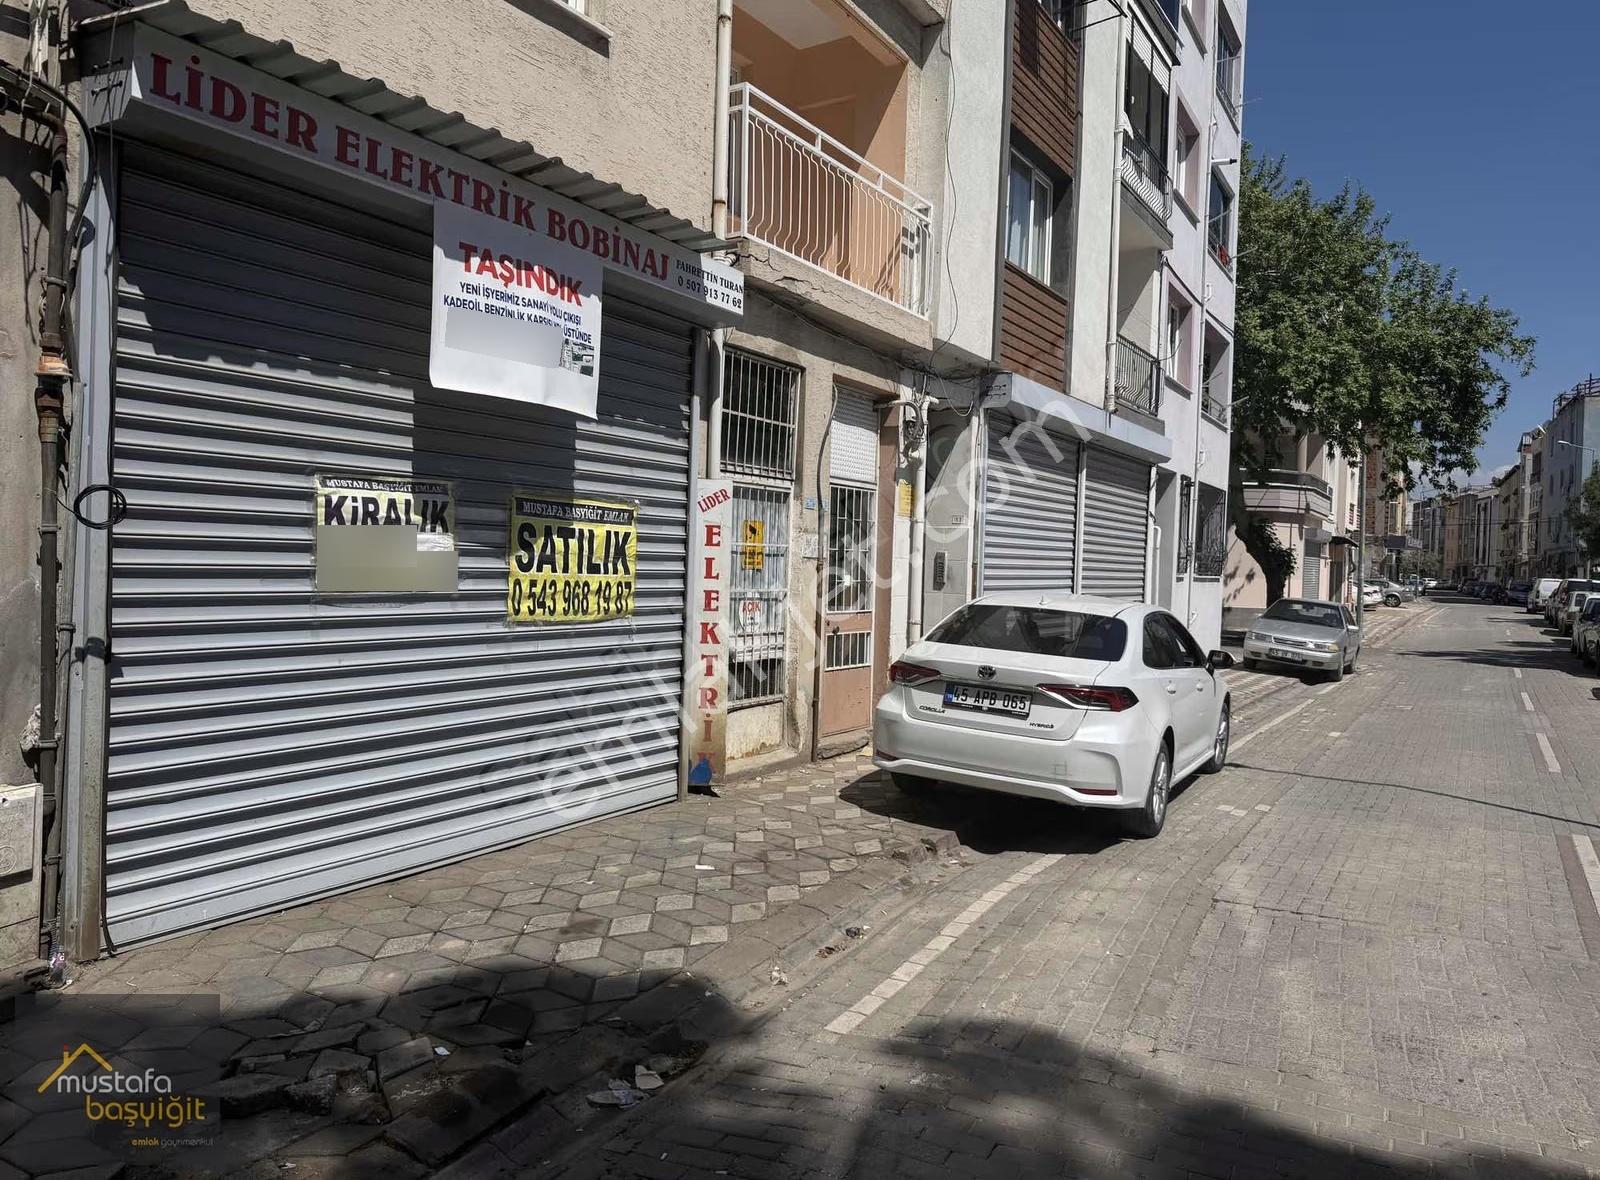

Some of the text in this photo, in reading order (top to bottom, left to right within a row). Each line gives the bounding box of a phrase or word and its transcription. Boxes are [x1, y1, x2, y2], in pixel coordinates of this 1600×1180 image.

[150, 53, 670, 281] LİDER ELEKTRİK BOBİNAJ
[459, 241, 583, 307] TAŞINDIK
[676, 260, 744, 294] FAHRETTİN TURAN
[459, 281, 481, 296] YENİ
[521, 297, 550, 312] SANAYİ
[677, 275, 742, 309] 0 507 913 77 62
[563, 324, 592, 344] ÜSTÜNDE
[523, 501, 563, 516] MUSTAFA
[697, 488, 731, 513] LİDER
[515, 522, 632, 575] SATILIK
[511, 578, 632, 616] 0 543 968 19 87
[953, 686, 968, 702] 45
[974, 689, 998, 706] APB
[1002, 694, 1027, 711] 065
